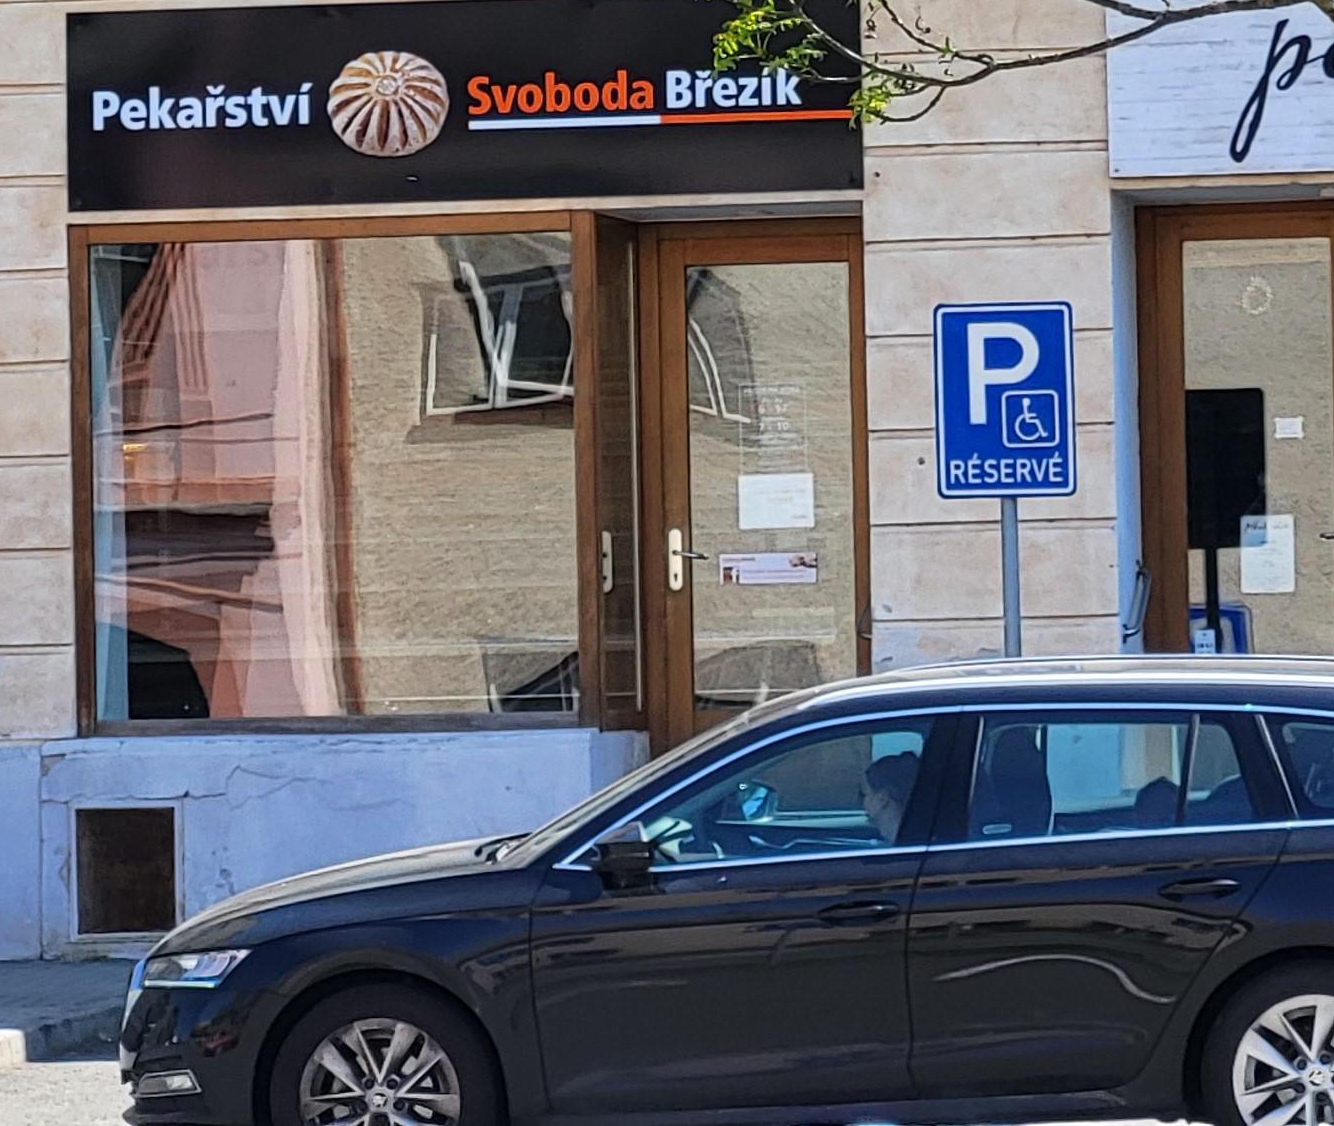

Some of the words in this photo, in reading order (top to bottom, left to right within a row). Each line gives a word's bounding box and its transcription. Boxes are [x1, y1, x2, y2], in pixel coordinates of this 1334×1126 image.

[92, 82, 314, 131] Pekařství
[468, 70, 655, 115] Svoboda
[666, 67, 802, 109] Březík
[967, 322, 1040, 425] P
[949, 451, 1064, 484] RÉSERVÉ
